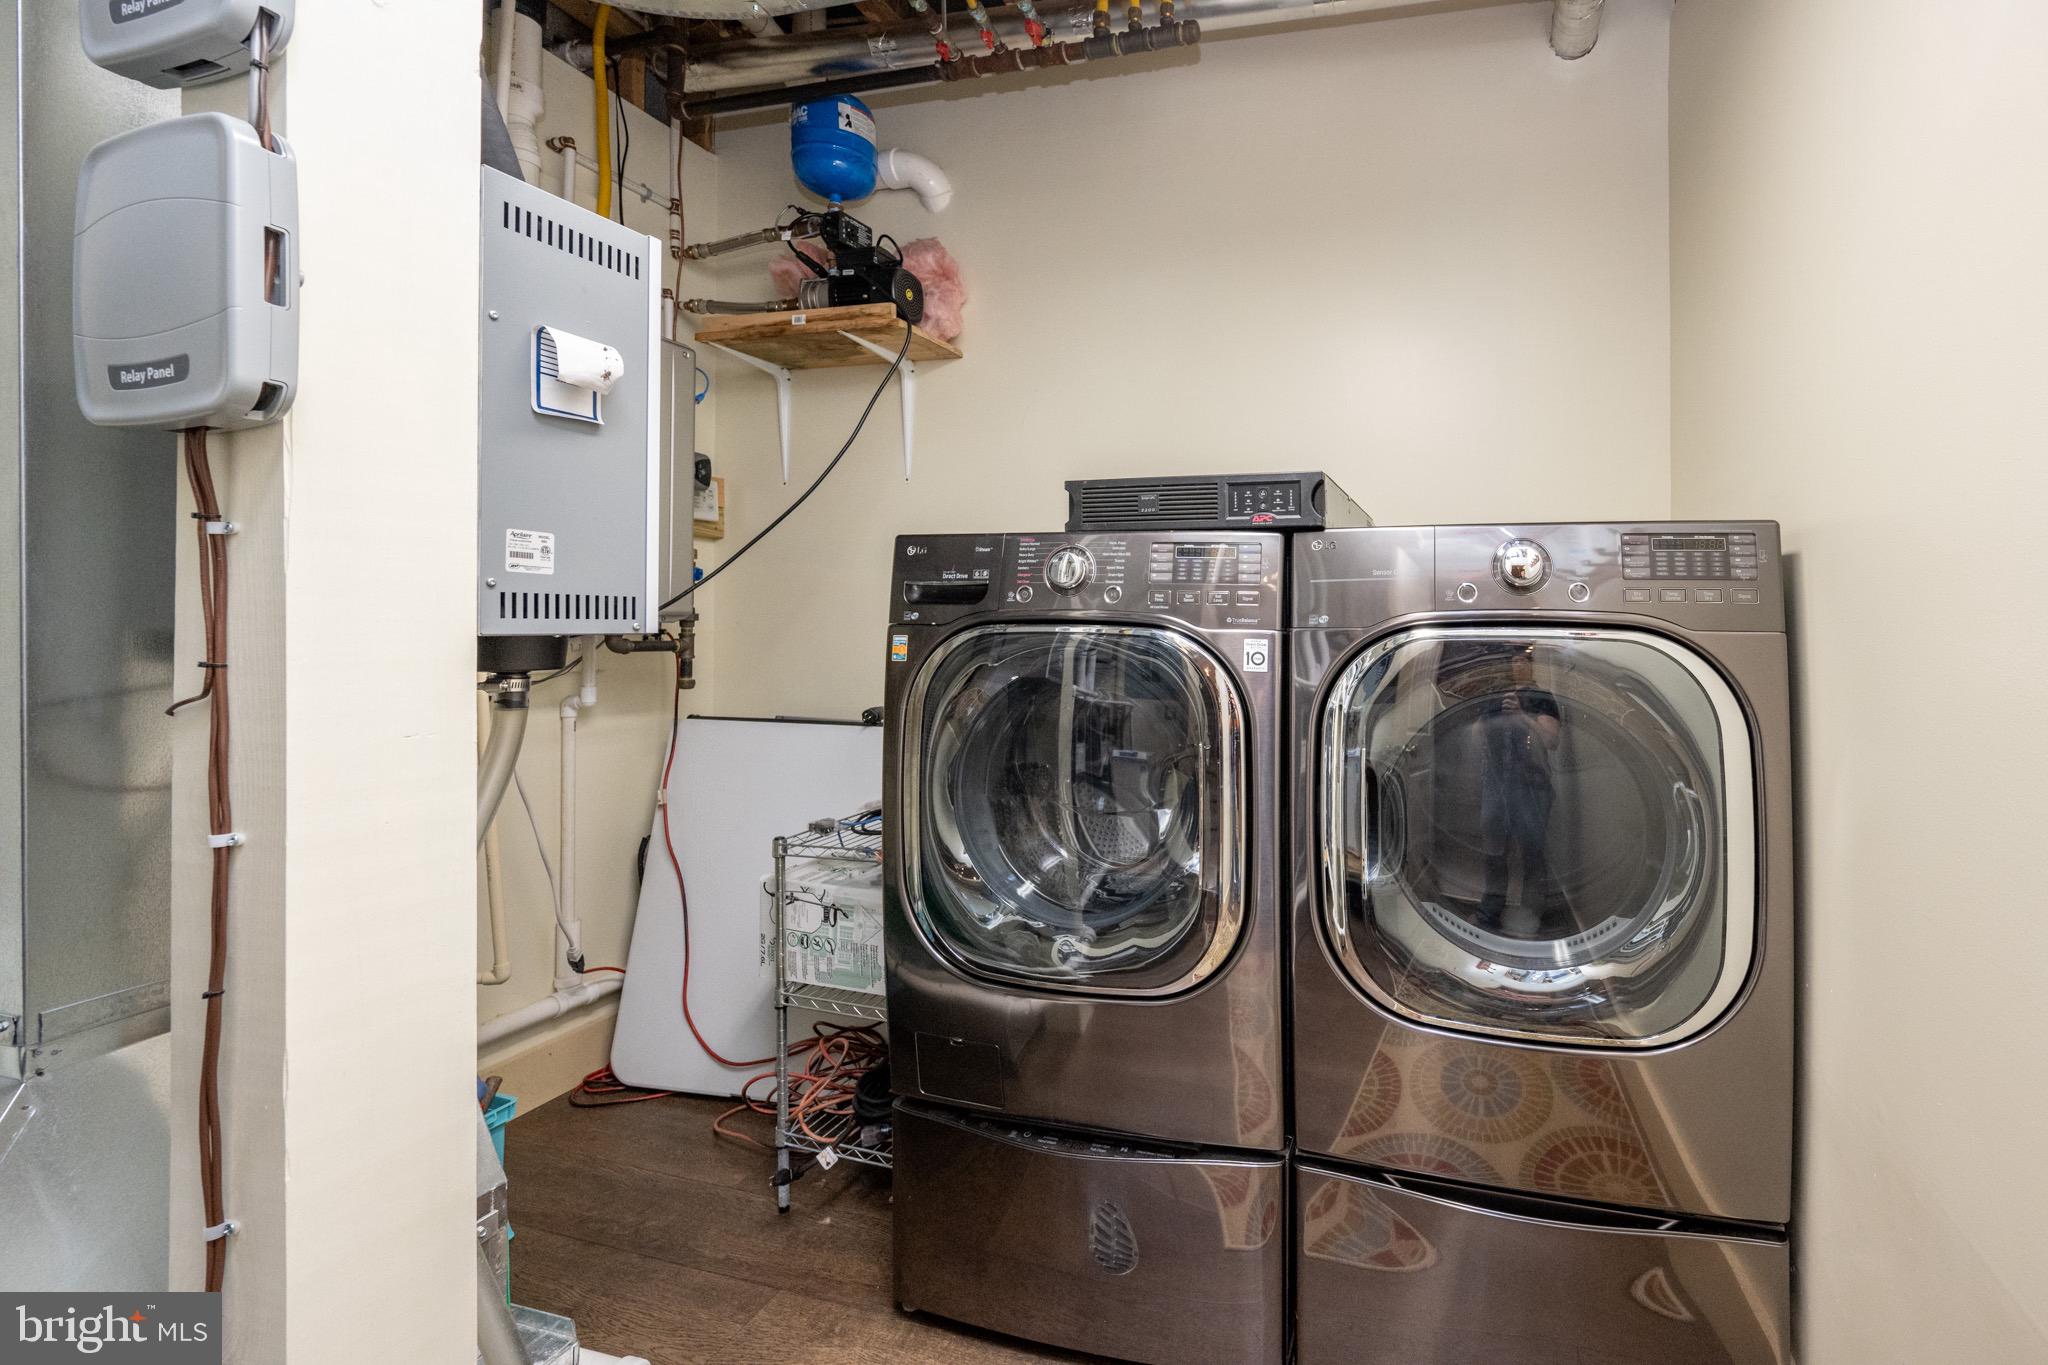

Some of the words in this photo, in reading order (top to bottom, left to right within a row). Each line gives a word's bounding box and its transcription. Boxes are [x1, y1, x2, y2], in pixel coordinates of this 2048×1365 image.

[121, 0, 145, 16] Relay
[120, 369, 146, 384] Relay
[147, 363, 174, 379] Panel
[1246, 651, 1265, 666] 10
